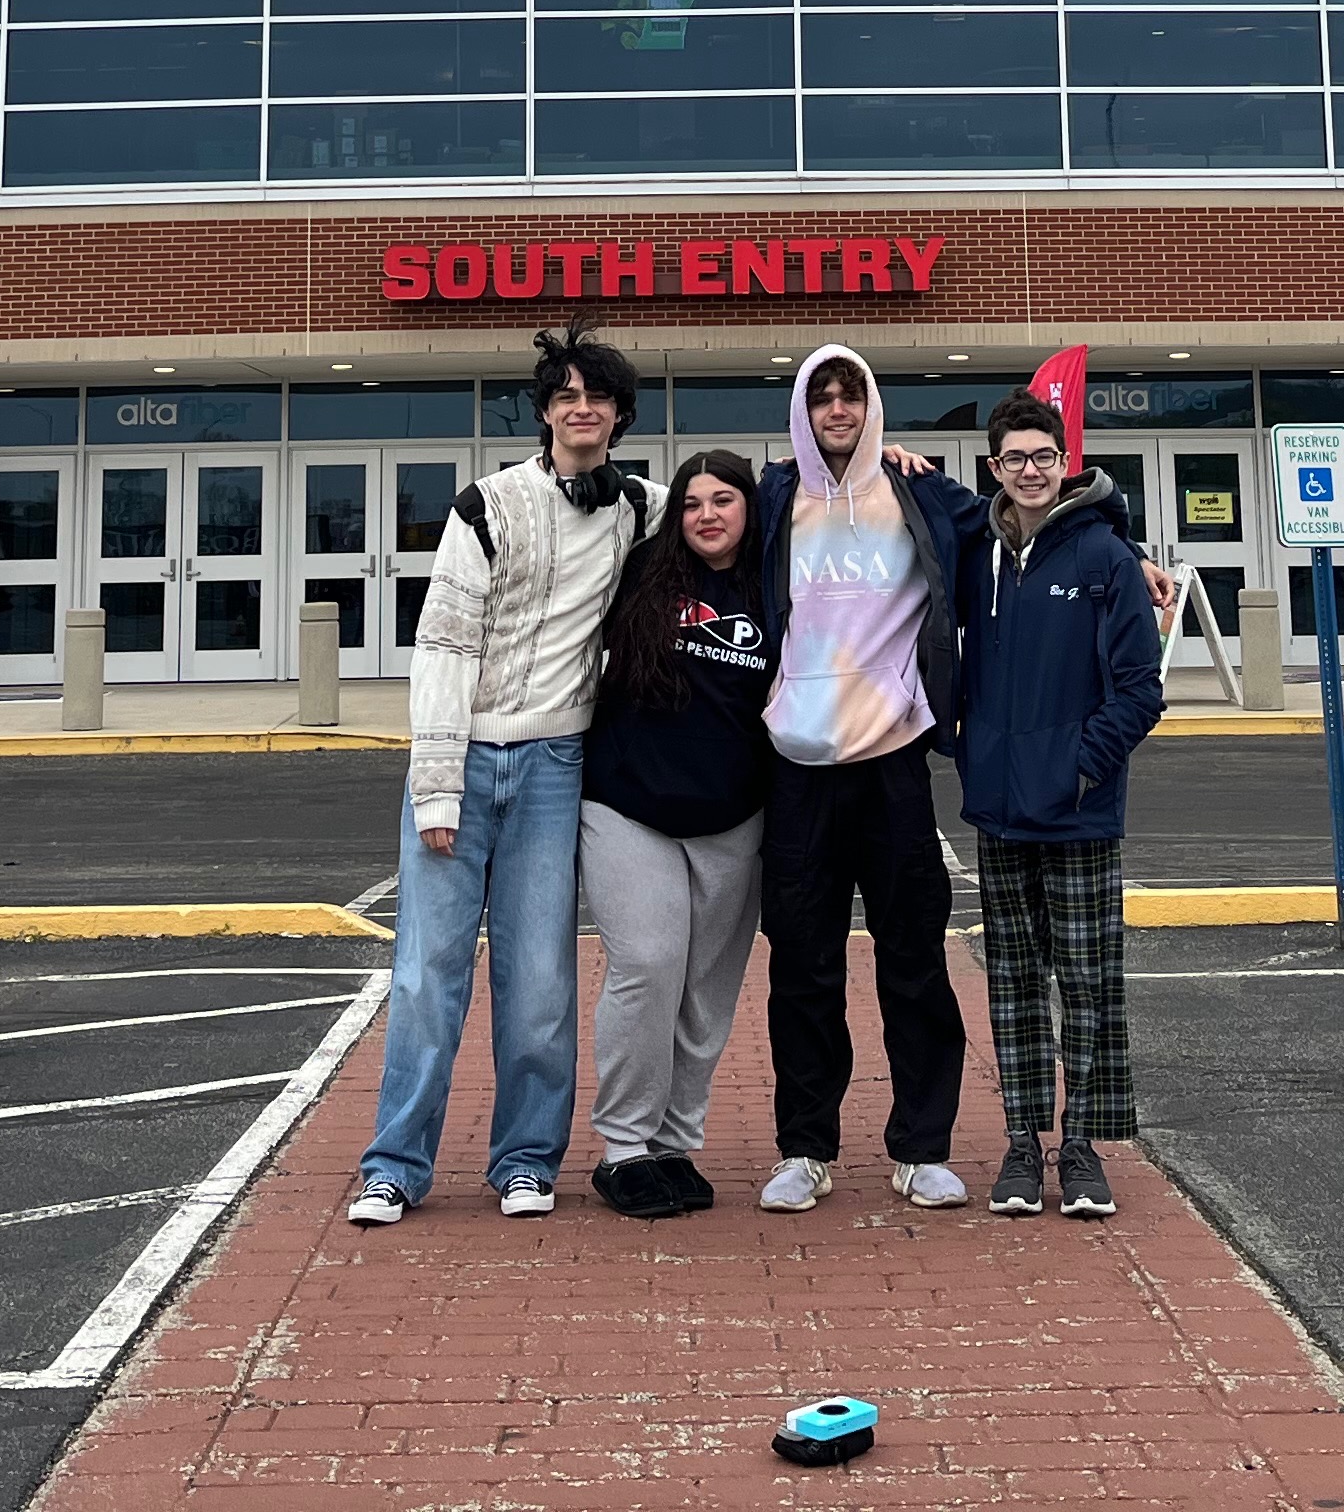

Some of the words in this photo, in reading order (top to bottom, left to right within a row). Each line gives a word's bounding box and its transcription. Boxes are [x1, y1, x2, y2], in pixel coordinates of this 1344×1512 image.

[381, 240, 655, 301] SOUTH
[680, 236, 947, 296] ENTRY
[1284, 436, 1340, 448] RESERVED
[1289, 451, 1338, 463] PARKING
[1307, 507, 1329, 518] VAN
[795, 550, 892, 586] NASA
[733, 620, 754, 645] P
[686, 641, 767, 671] PERCUSSION
